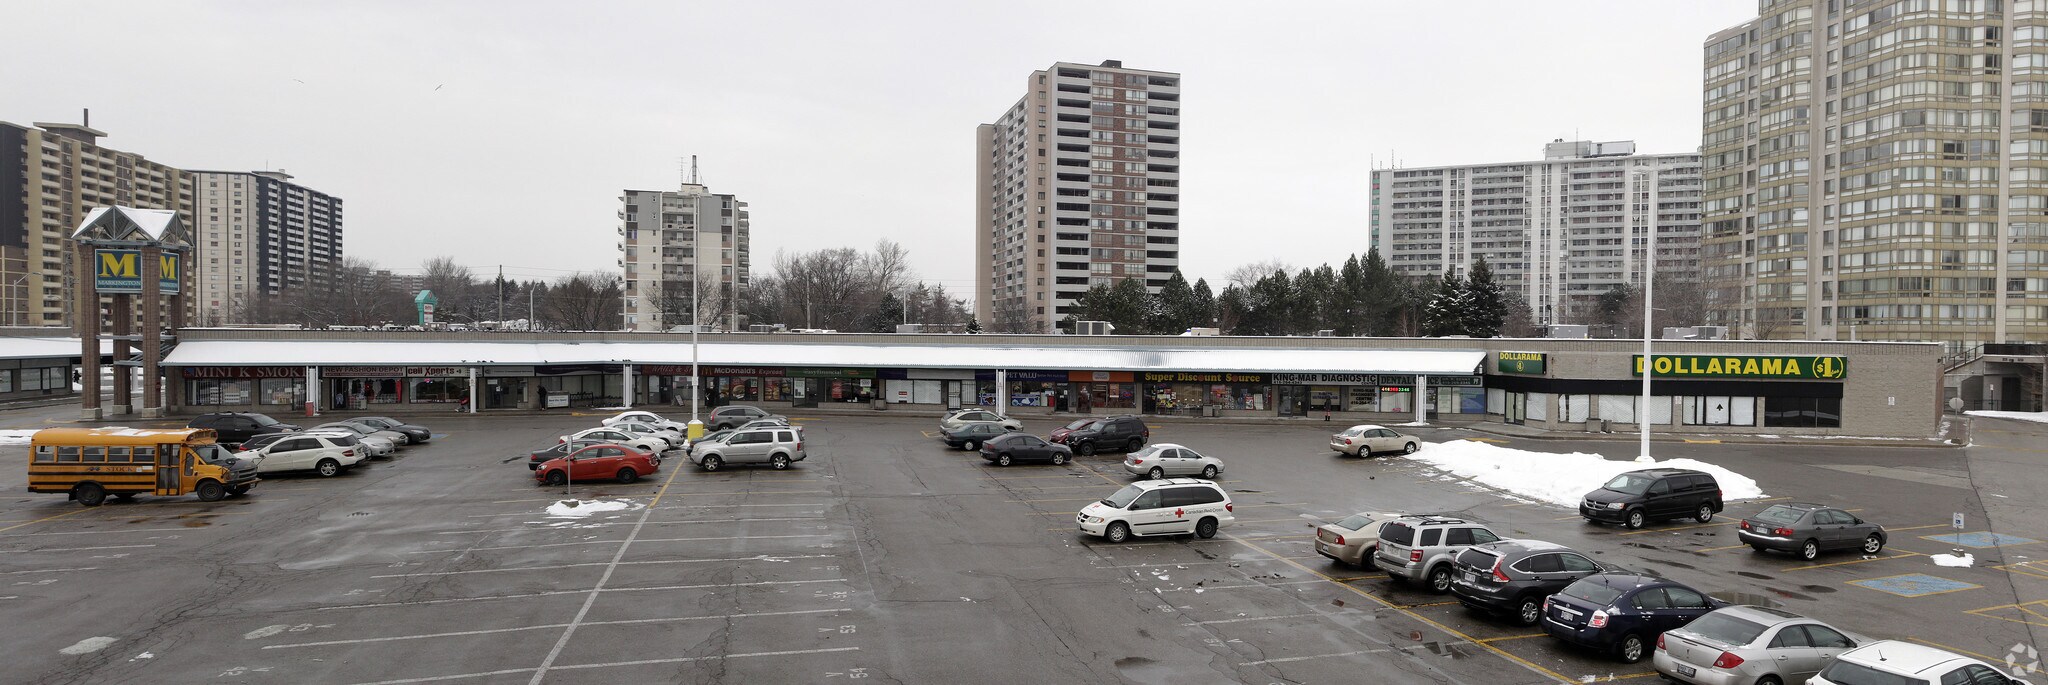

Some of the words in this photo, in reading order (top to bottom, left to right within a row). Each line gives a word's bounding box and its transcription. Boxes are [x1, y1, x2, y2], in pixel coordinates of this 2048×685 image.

[97, 253, 139, 278] M
[1500, 352, 1542, 361] DOLLARAMA
[1636, 356, 1801, 375] DOLLARAMA
[195, 367, 232, 378] MINI
[240, 367, 251, 378] K
[408, 367, 423, 375] cell
[424, 366, 455, 377] Xperts
[1145, 372, 1174, 382] Super
[1178, 373, 1221, 381] Discount
[1226, 373, 1260, 382] Source
[1381, 376, 1413, 384] DENTAL
